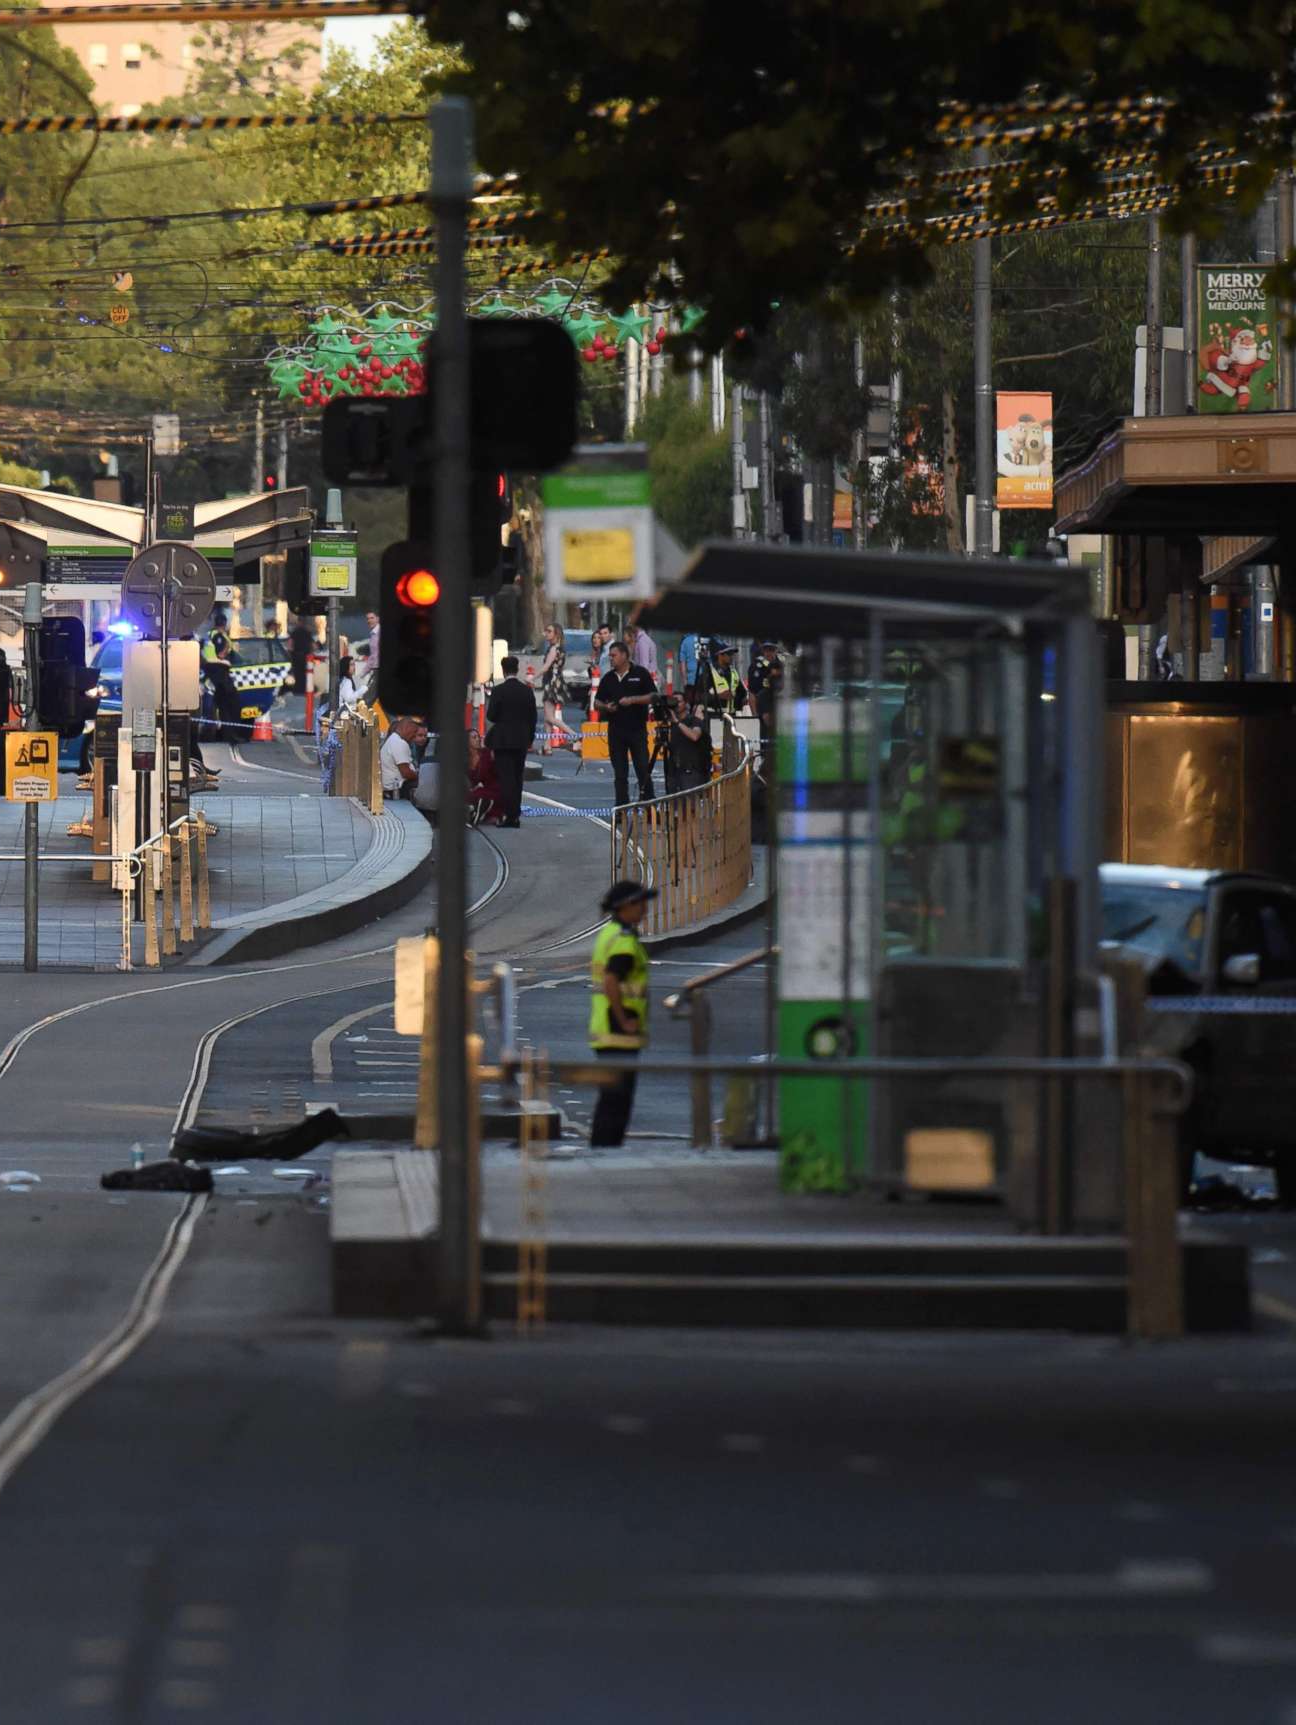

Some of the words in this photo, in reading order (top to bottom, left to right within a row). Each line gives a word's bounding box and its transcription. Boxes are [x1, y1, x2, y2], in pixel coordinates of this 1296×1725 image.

[1208, 273, 1267, 288] MERRY
[1207, 289, 1266, 302] CHRISTMAS
[1208, 301, 1266, 310] MELBOURNE
